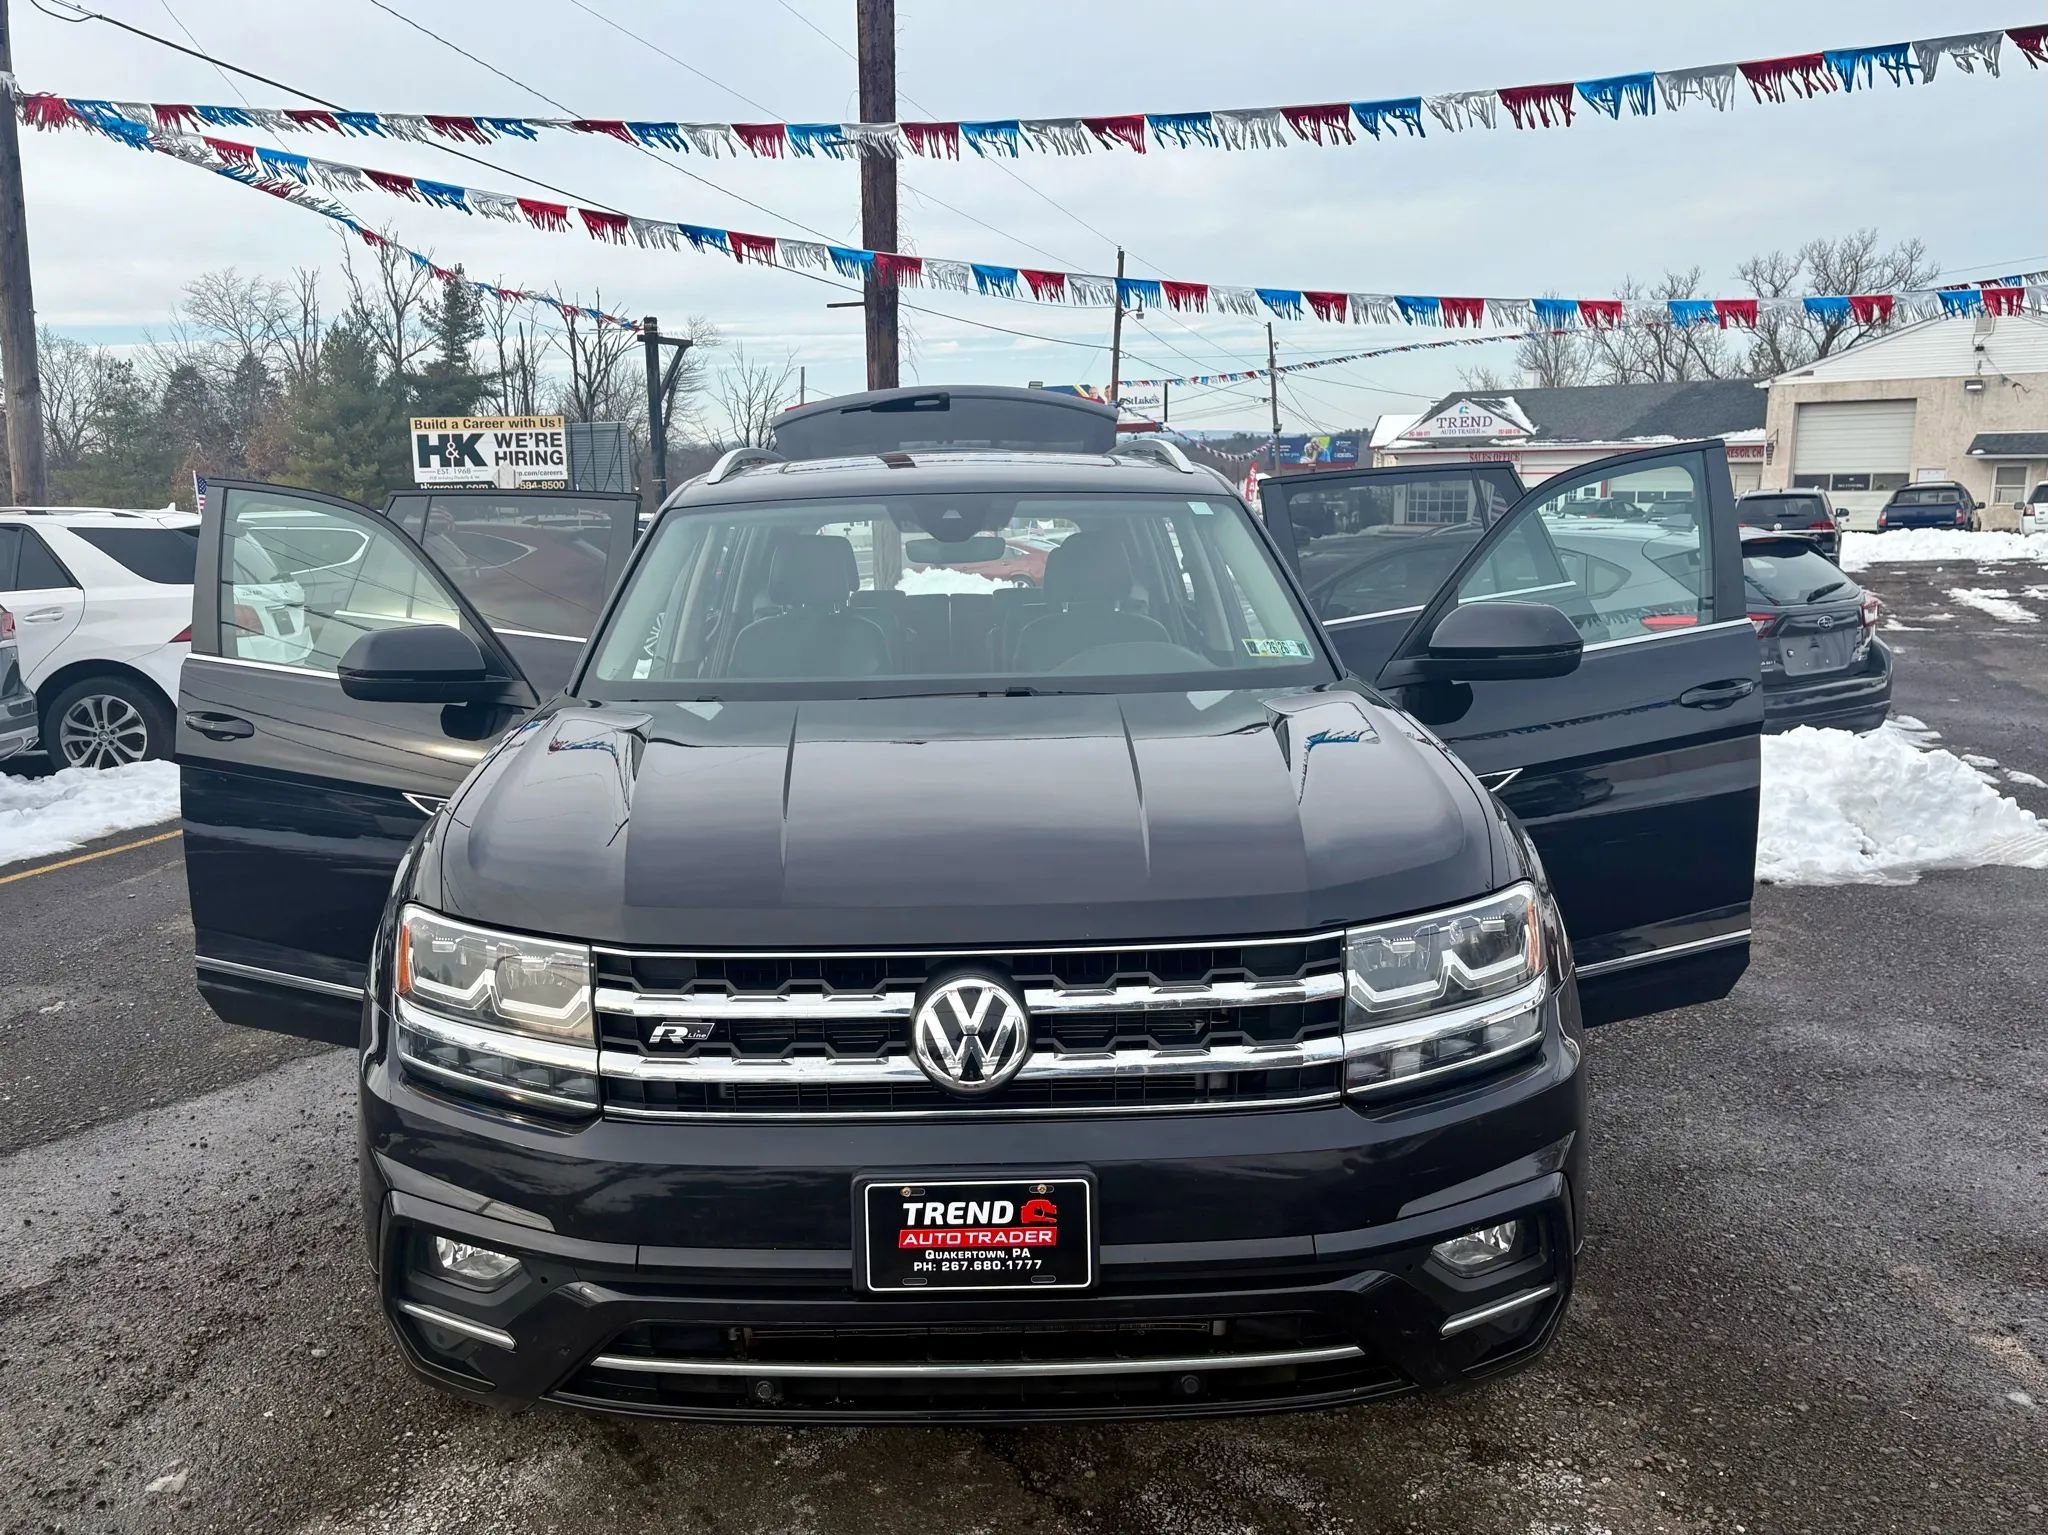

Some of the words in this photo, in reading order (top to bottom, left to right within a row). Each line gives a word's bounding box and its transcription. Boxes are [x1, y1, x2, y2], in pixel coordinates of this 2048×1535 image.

[414, 420, 446, 429] Build
[463, 418, 504, 428] Career
[508, 418, 536, 428] with
[1436, 416, 1492, 428] TREND
[494, 432, 562, 448] WE'RE
[416, 434, 488, 468] H&K
[494, 450, 564, 466] HIRING
[903, 1200, 1014, 1226] TREND
[903, 1231, 962, 1246] AUTO
[966, 1230, 1052, 1244] TRADER
[1013, 1248, 1031, 1258] PA
[914, 1262, 936, 1272] PH:
[942, 1260, 1042, 1271] 267.680.1777
